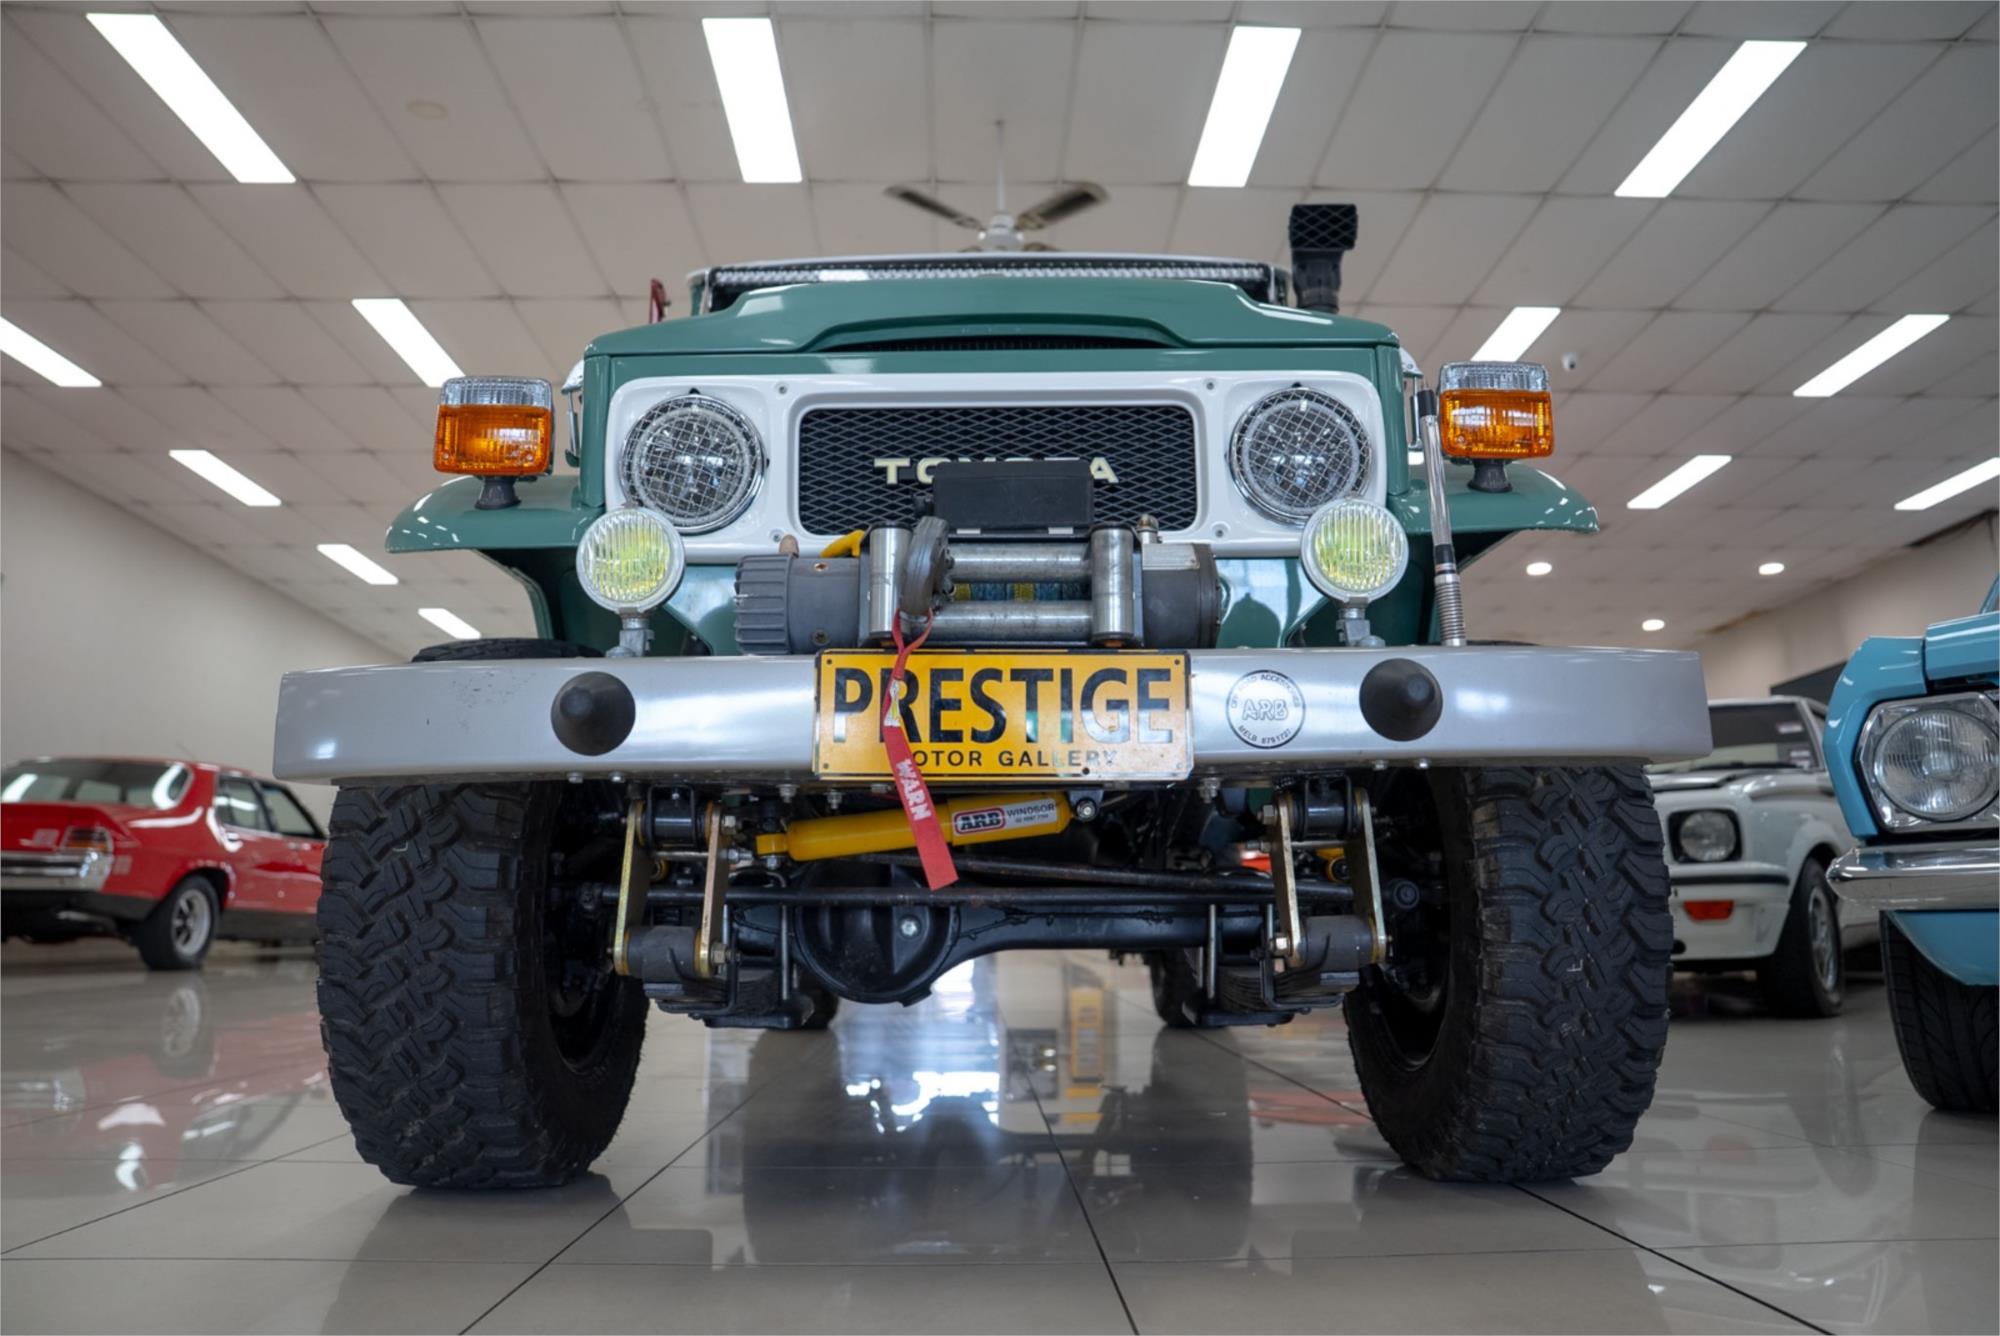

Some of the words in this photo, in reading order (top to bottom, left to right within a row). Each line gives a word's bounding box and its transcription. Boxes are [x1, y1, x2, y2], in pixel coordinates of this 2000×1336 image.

[873, 457, 1119, 485] TOA
[833, 667, 1173, 744] PRESTIGE
[1241, 698, 1289, 721] ARB
[908, 750, 982, 767] OTOR
[998, 750, 1118, 767] GALLERY
[895, 758, 932, 821] WARN
[960, 811, 1001, 831] ARB
[1006, 803, 1055, 817] WINDSOR
